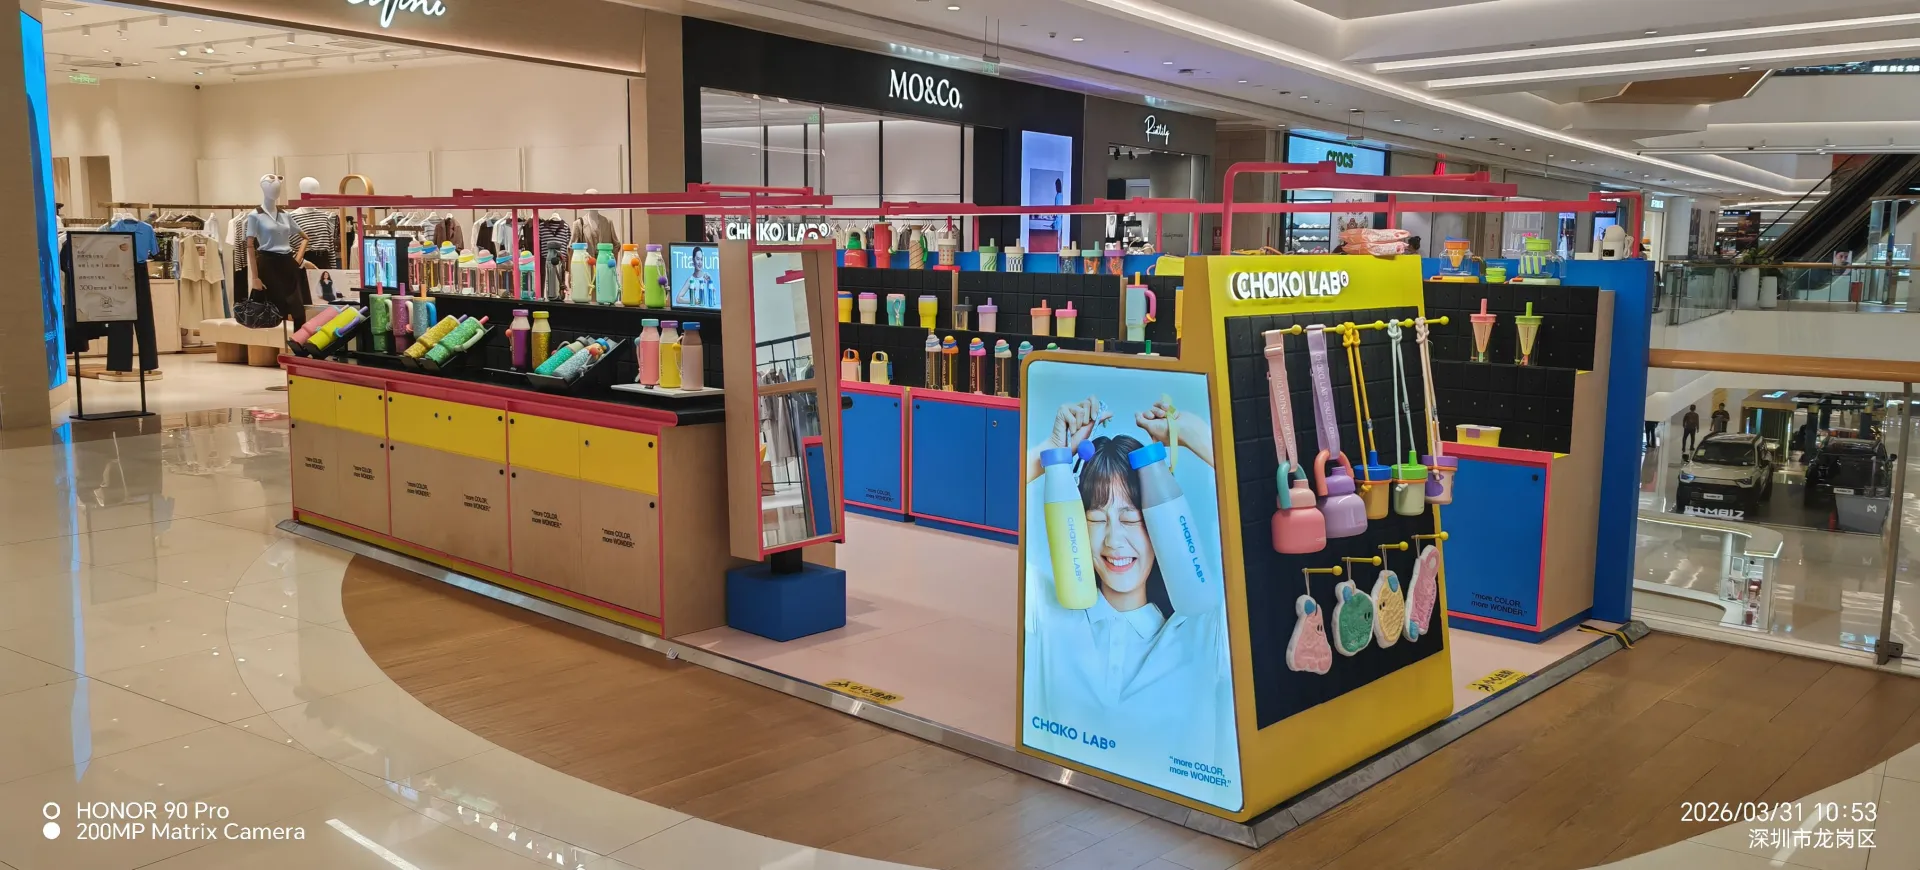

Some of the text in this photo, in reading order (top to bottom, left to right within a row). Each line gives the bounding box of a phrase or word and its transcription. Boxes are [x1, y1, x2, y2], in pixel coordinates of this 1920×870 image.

[888, 69, 963, 109] MO&Co.
[1326, 150, 1354, 168] crocs
[1169, 756, 1225, 777] “more COLOR,
[1169, 766, 1231, 788] more WONDER.”
